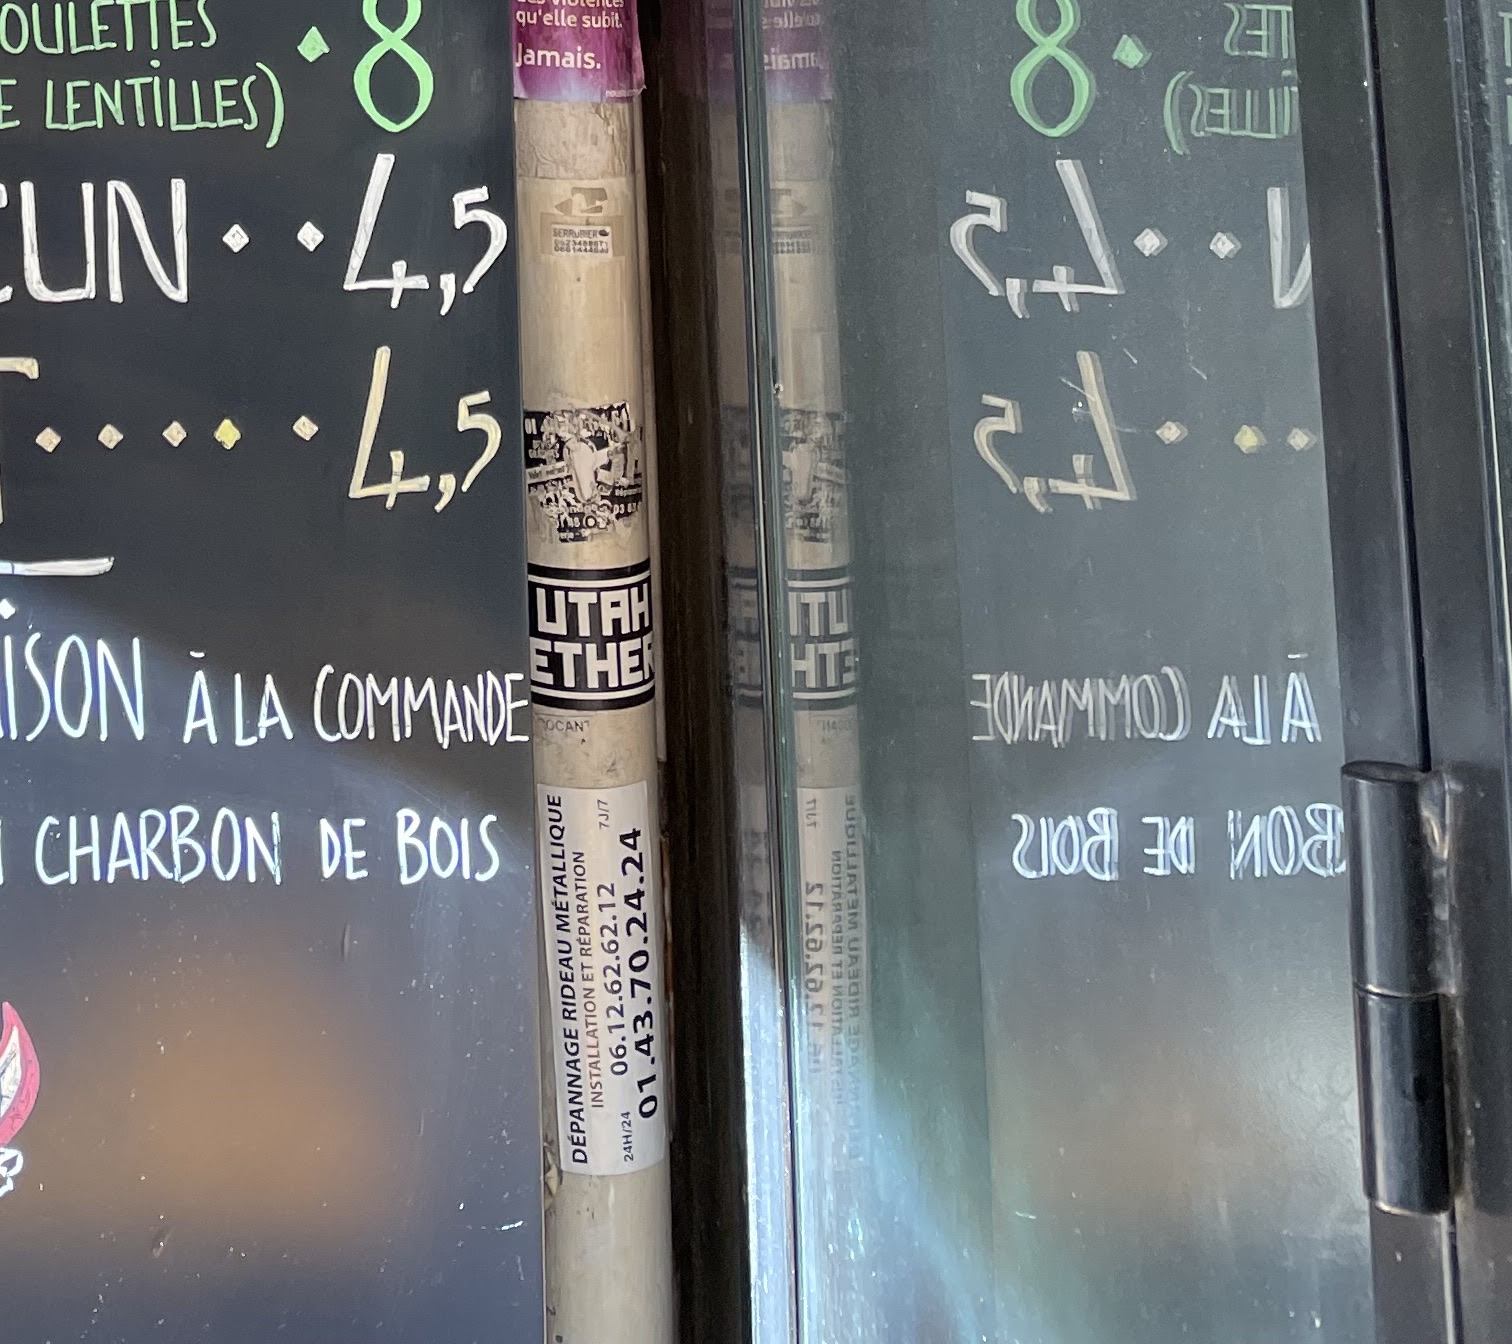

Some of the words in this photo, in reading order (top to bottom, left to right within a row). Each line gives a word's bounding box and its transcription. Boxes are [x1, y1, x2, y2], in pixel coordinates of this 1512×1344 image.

[515, 43, 602, 70] Jamais.
[516, 9, 578, 27] qu'elle
[582, 11, 623, 29] subit.
[45, 60, 286, 149] LENTILLES)
[342, 153, 508, 315] 4,5
[347, 345, 502, 512] 4,5
[536, 582, 650, 637] UTAH
[234, 673, 294, 746] LA
[313, 664, 530, 749] COMMANDE
[35, 806, 284, 887] CHARBON
[320, 815, 369, 879] DE
[397, 808, 500, 886] BOIS
[597, 798, 611, 830] 7J/7
[546, 795, 571, 933] MÉTALLIQUE
[572, 852, 593, 956] RÉPARATION
[556, 941, 578, 1022] RIDEAU
[581, 962, 595, 982] ET
[597, 882, 629, 1076] 06.12.62.62.12
[619, 828, 658, 1119] 01.43.70.24.24
[582, 987, 604, 1108] INSTALLATION
[562, 1028, 588, 1164] DÉPANNAGE
[620, 1112, 634, 1162] 24H/24
